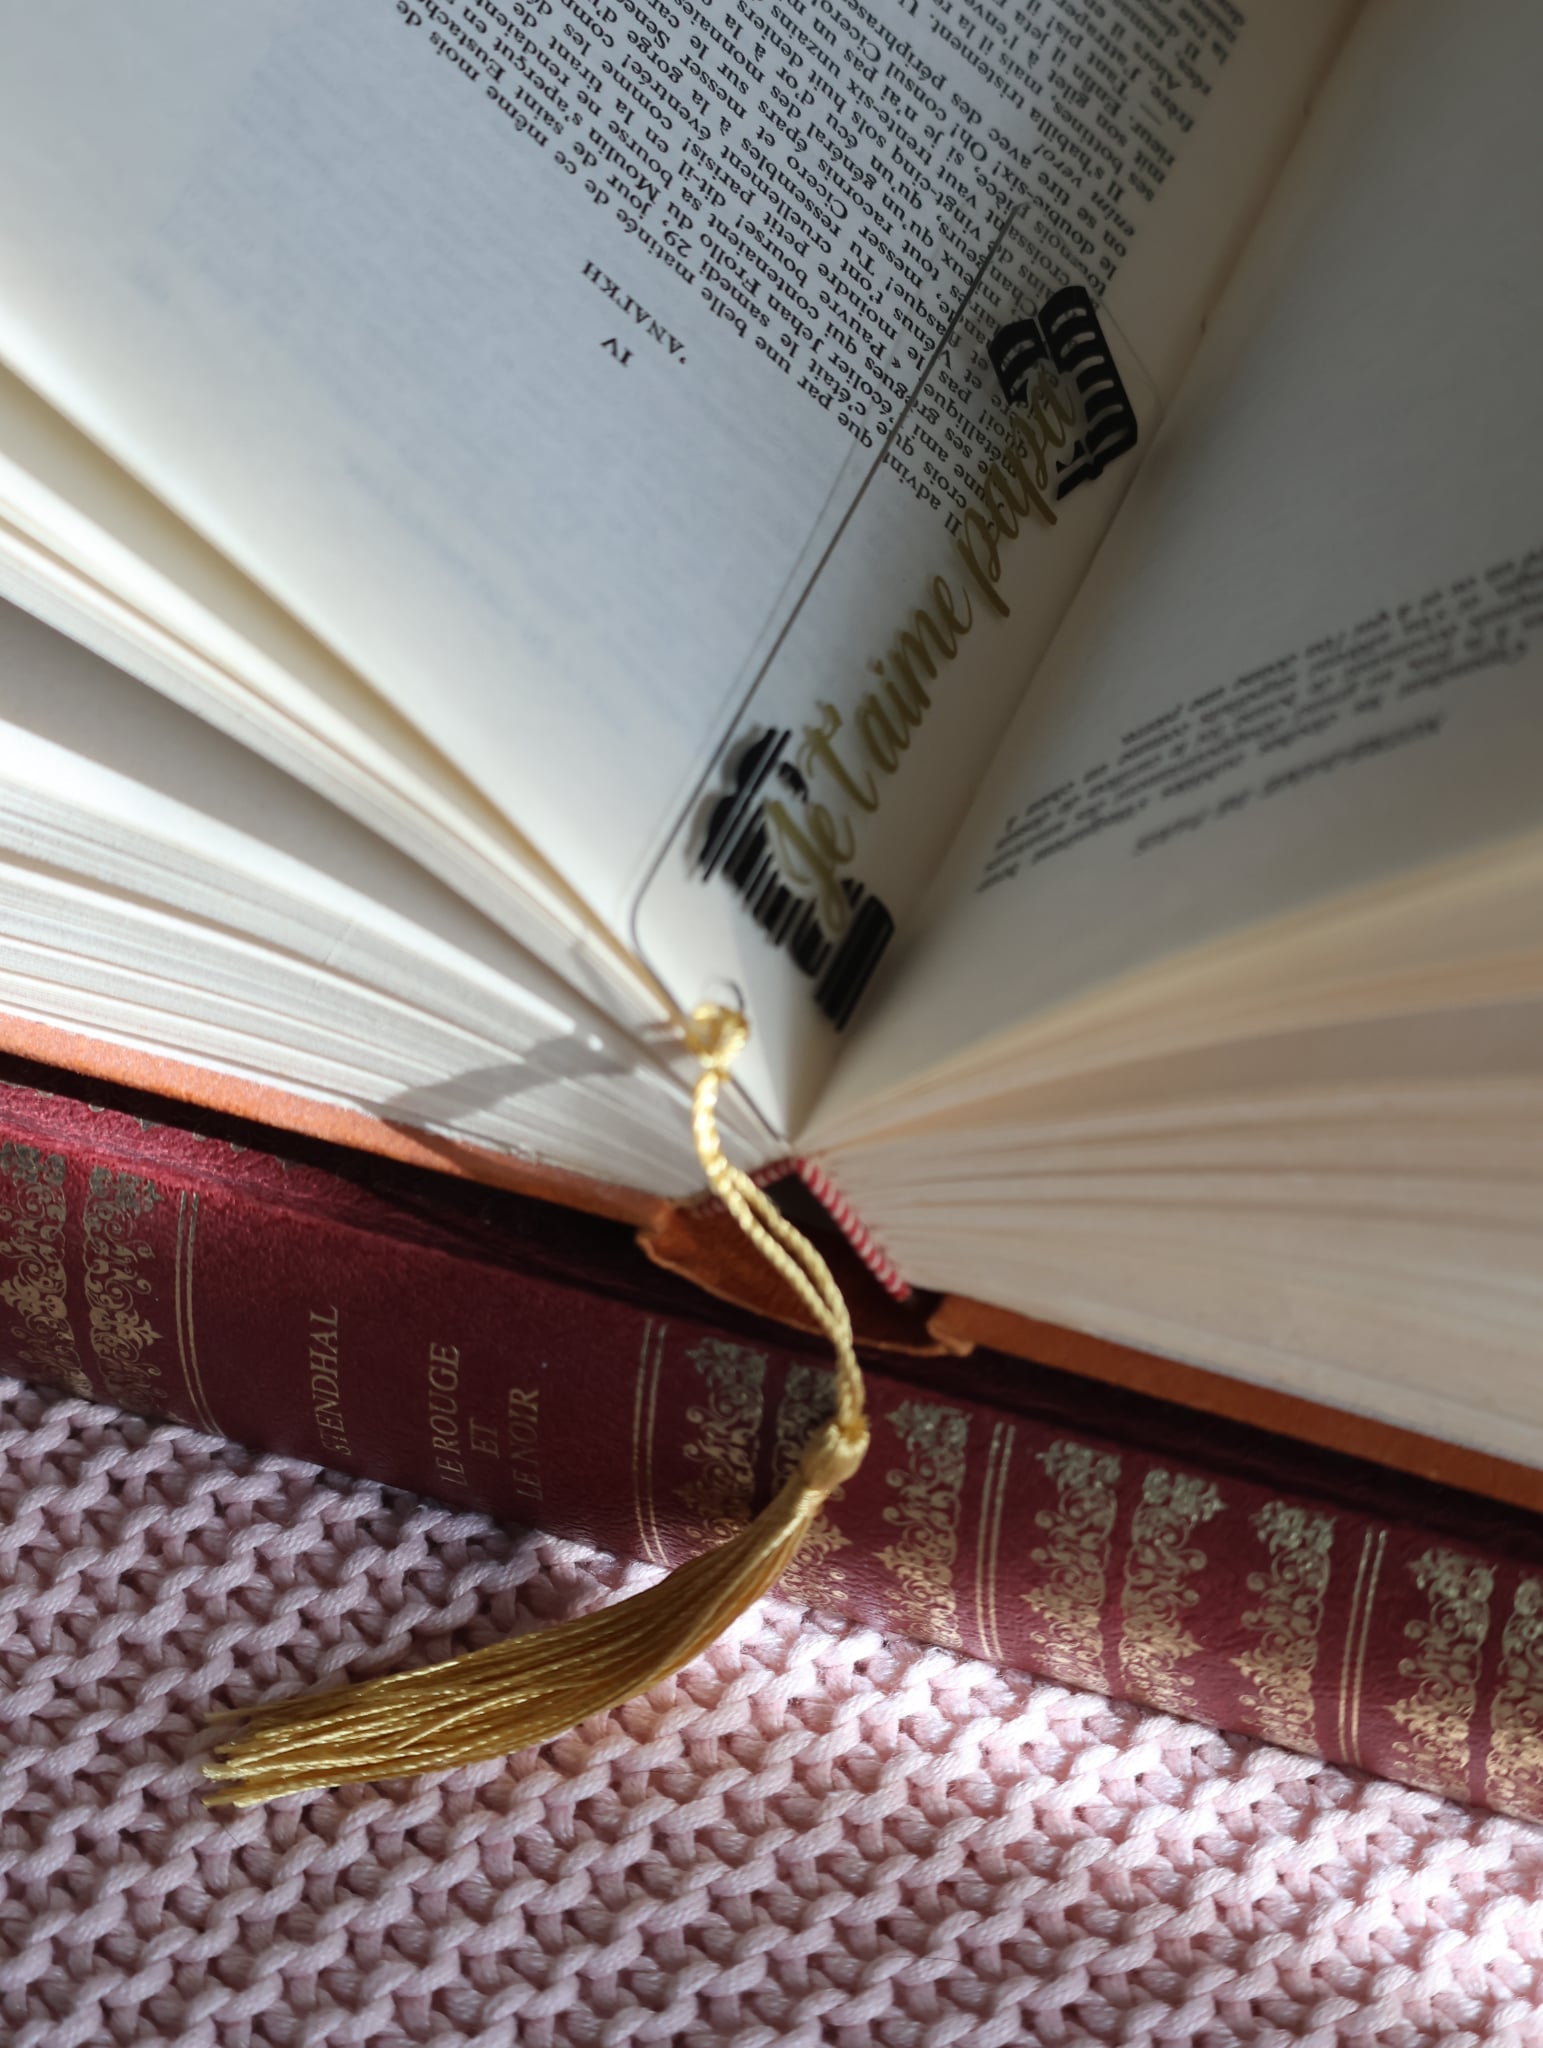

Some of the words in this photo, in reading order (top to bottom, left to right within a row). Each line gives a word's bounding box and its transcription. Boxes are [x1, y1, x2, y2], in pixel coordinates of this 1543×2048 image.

[396, 0, 422, 26] de
[463, 7, 487, 34] en
[513, 2, 537, 27] de
[724, 13, 743, 40] la
[813, 17, 837, 46] un
[958, 14, 976, 39] la
[1014, 10, 1050, 49] jeta
[419, 0, 505, 82] Eustach
[563, 23, 591, 56] les
[689, 35, 709, 60] le
[737, 0, 803, 67] deniers
[754, 42, 766, 62] à
[771, 5, 840, 78] unzains
[843, 0, 947, 90] périphrase
[978, 35, 994, 55] il
[429, 31, 480, 81] mois
[548, 35, 602, 93] tirant
[627, 30, 683, 83] gorge
[843, 48, 878, 83] pas
[999, 52, 1043, 96] mais
[1027, 49, 1040, 69] à
[1051, 46, 1067, 66] il
[493, 37, 583, 126] s'aperçut
[601, 60, 672, 130] comme
[621, 54, 711, 140] éventrée!
[679, 54, 747, 119] messer
[716, 63, 749, 94] sur
[775, 67, 815, 105] d'or
[808, 69, 847, 114] huit
[885, 61, 947, 121] consul
[1047, 69, 1090, 109] gilet
[486, 85, 548, 147] même
[515, 85, 564, 135] saint
[577, 90, 602, 116] ne
[615, 98, 634, 125] la
[691, 89, 710, 116] la
[770, 85, 801, 118] des
[846, 78, 932, 165] trente-six
[880, 84, 918, 122] n'ai
[951, 93, 982, 124] des
[645, 126, 669, 153] en
[719, 115, 731, 136] à
[756, 125, 775, 147] et
[758, 100, 807, 152] épars
[826, 112, 858, 149] écu
[851, 110, 886, 148] sols
[923, 124, 944, 147] je
[950, 123, 988, 162] Oh!
[1029, 107, 1104, 179] s'habilla
[1096, 113, 1127, 147] son
[554, 150, 577, 175] ce
[573, 141, 597, 166] de
[589, 127, 660, 203] Moulin
[608, 120, 673, 189] bourse
[806, 122, 877, 190] général
[946, 145, 964, 165] si
[988, 128, 1032, 169] avec
[1133, 150, 1166, 184] mit
[678, 159, 726, 206] dit-il
[681, 137, 756, 205] parisis!
[741, 138, 841, 237] ressembles
[786, 155, 848, 219] Cicero
[870, 155, 922, 209] qu'un
[937, 165, 976, 209] vaut
[1037, 171, 1070, 206] tire
[1107, 180, 1124, 202] Il
[1128, 171, 1155, 202] ses
[584, 179, 609, 204] de
[606, 175, 652, 219] jour
[681, 186, 702, 211] sa
[720, 145, 831, 253] cruellement
[818, 158, 893, 235] racornis
[891, 144, 980, 241] vingt-cinq
[667, 201, 693, 229] du
[882, 193, 934, 247] qu'un
[1076, 207, 1097, 229] se
[1090, 191, 1135, 236] enim
[616, 208, 695, 284] matinée
[662, 219, 692, 258] 29,
[735, 214, 807, 288] bourse!
[763, 211, 810, 257] petit
[984, 209, 1070, 293] croissant
[1103, 229, 1126, 257] on
[700, 233, 761, 297] Frollo
[708, 213, 819, 319] contenaient
[849, 240, 875, 276] Tu
[858, 226, 923, 289] messer
[901, 239, 939, 281] tout
[1099, 256, 1117, 280] le
[699, 259, 770, 327] samedi
[840, 258, 883, 304] t'ont
[941, 249, 1001, 307] mieux
[701, 287, 747, 338] belle
[817, 263, 897, 340] moindre
[767, 293, 824, 353] Jehan
[824, 321, 857, 354] qui
[600, 338, 634, 367] IV
[755, 336, 791, 374] une
[780, 333, 799, 358] le
[907, 346, 925, 371] le
[970, 350, 989, 371] et
[797, 376, 834, 410] par
[808, 358, 866, 416] c'était
[828, 352, 907, 431] 'écolier
[864, 349, 940, 425] grègues
[938, 370, 972, 404] pas
[963, 368, 982, 389] et
[837, 412, 872, 448] que
[876, 412, 914, 456] que
[911, 423, 949, 462] ami
[944, 427, 973, 458] ses
[878, 448, 941, 510] advint
[923, 461, 967, 509] crois
[944, 511, 962, 537] Il
[764, 800, 855, 937] Je
[309, 1305, 353, 1456] STENDHAL
[429, 1341, 461, 1456] ROUGE
[468, 1416, 500, 1460] ET
[507, 1386, 541, 1464] NOIR
[439, 1457, 469, 1488] LE
[513, 1469, 543, 1503] LE
